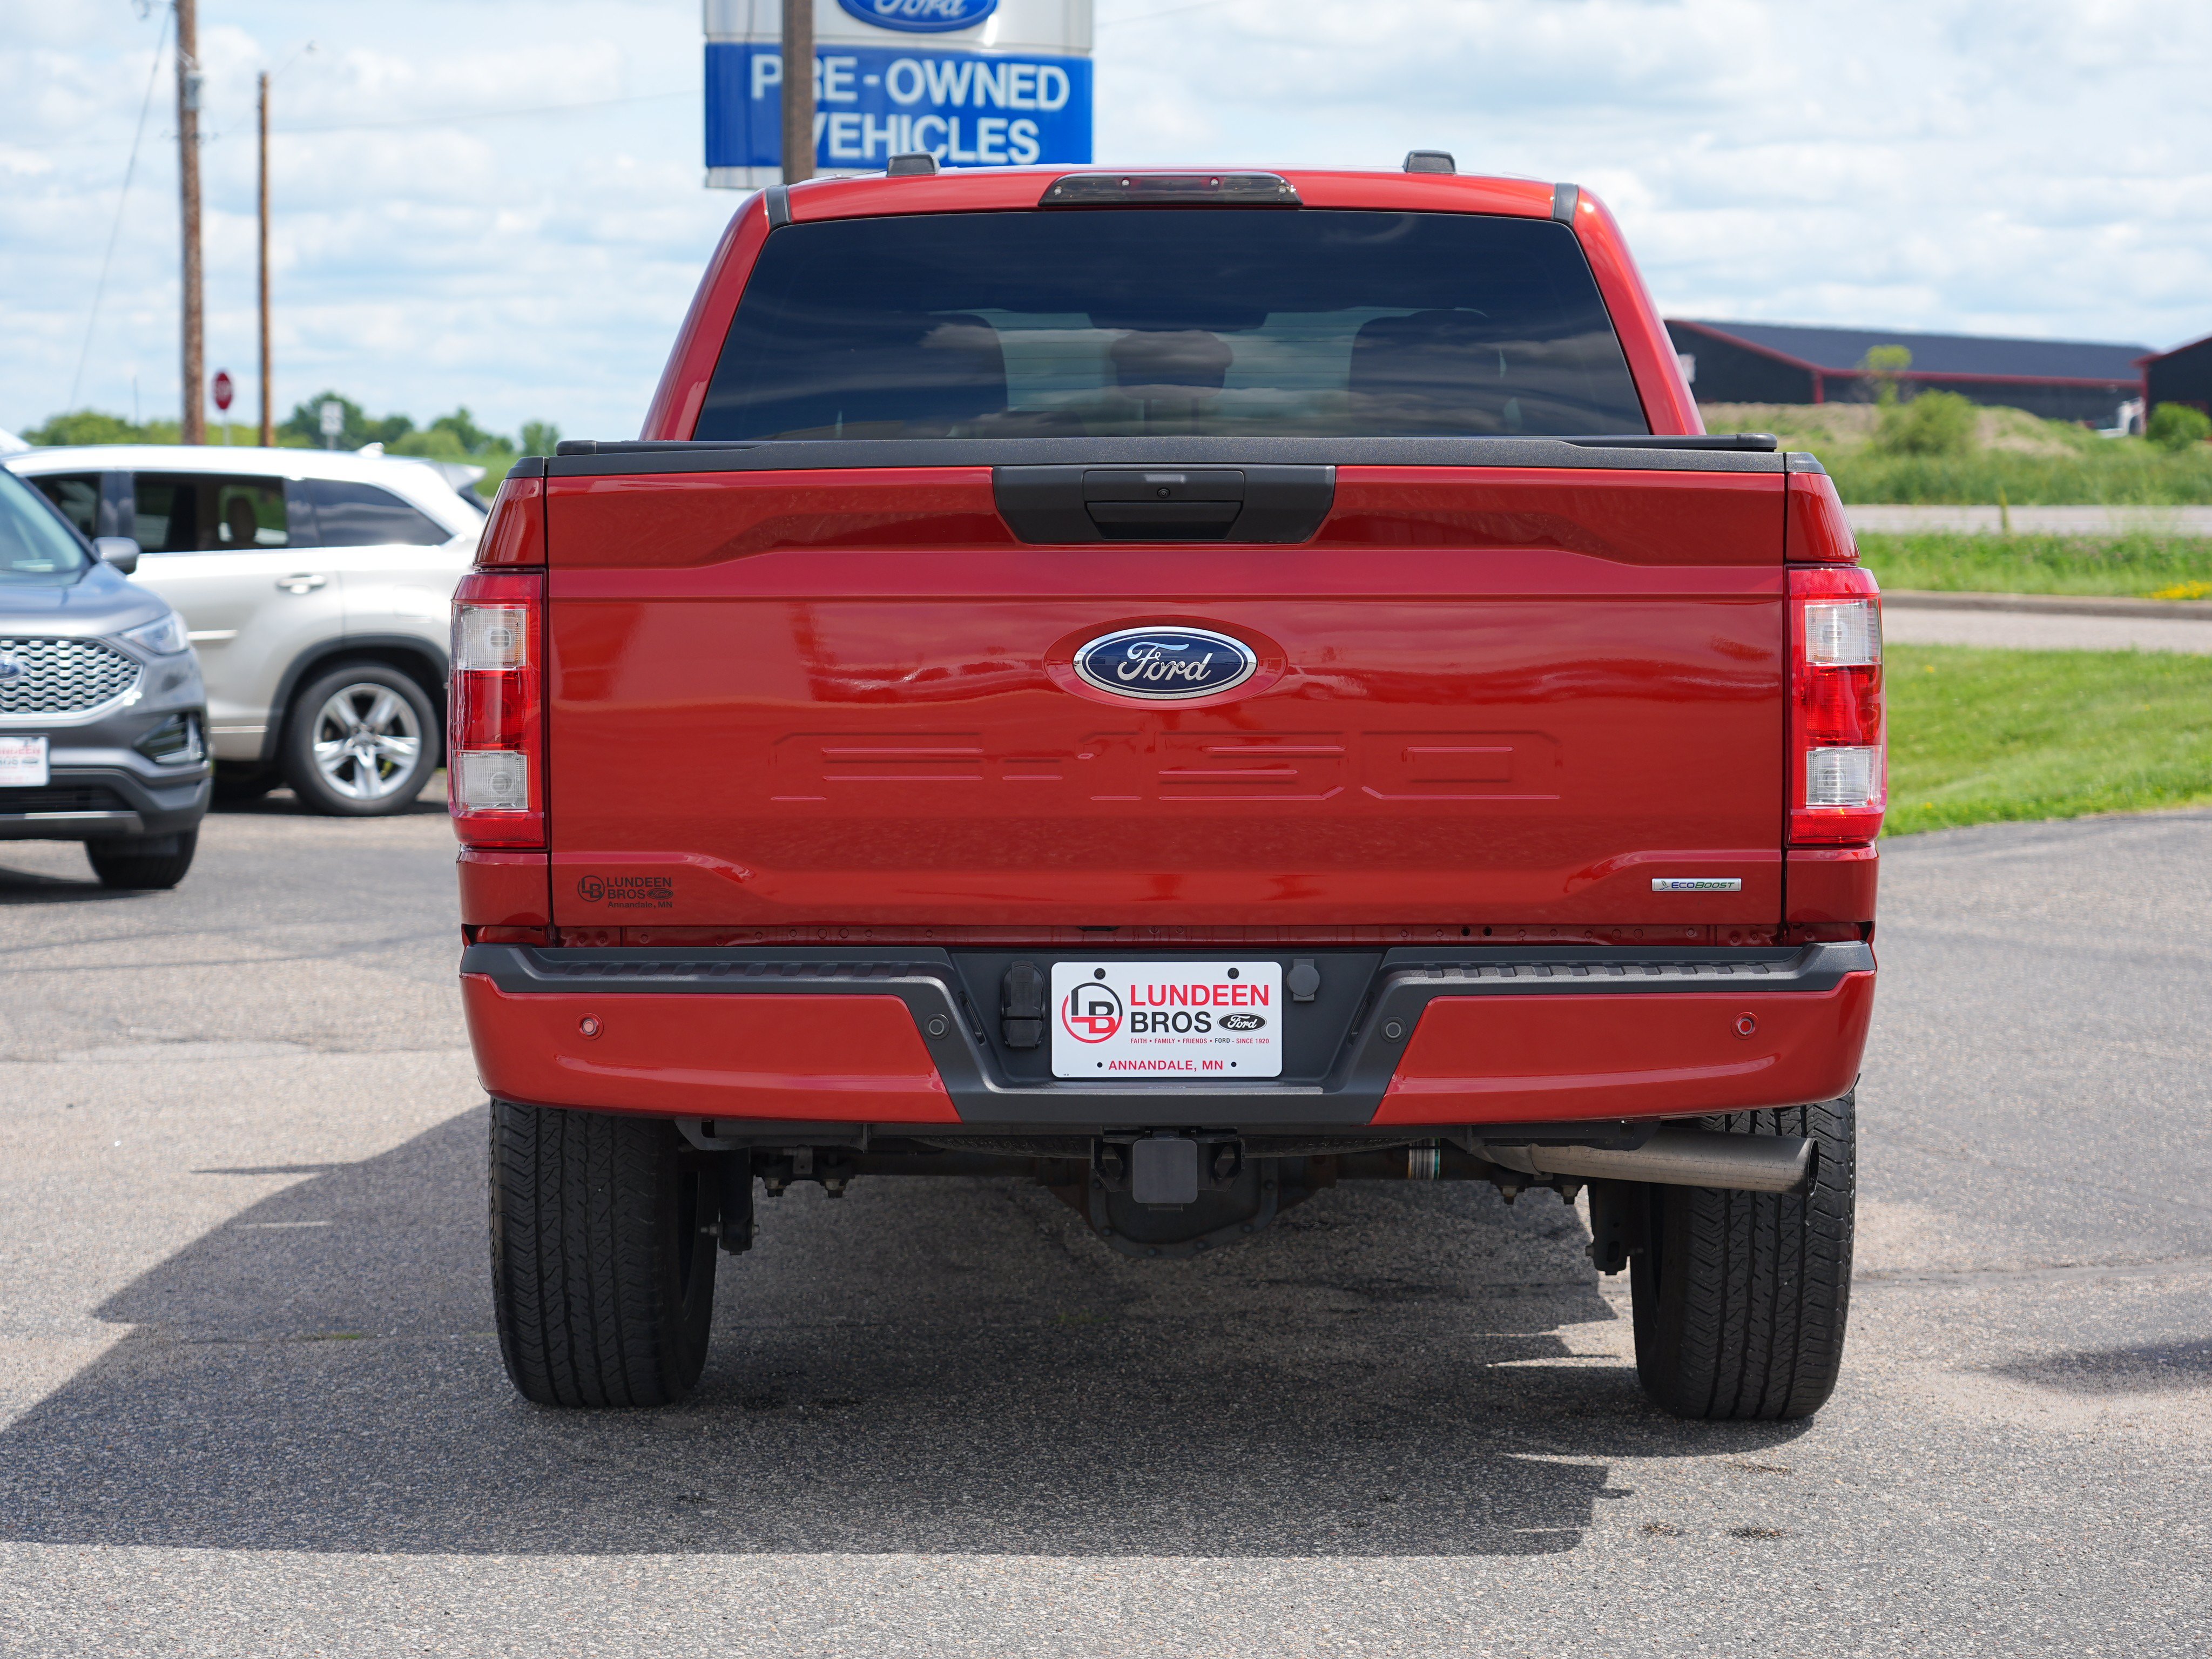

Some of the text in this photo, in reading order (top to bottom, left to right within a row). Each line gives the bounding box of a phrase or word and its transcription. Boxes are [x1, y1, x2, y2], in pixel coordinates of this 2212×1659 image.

[1117, 642, 1213, 680] Ford
[606, 877, 672, 887] LUNDEEN
[608, 889, 645, 899] BROS
[1130, 984, 1269, 1006] LUNDEEN
[1131, 1011, 1258, 1033] BROS Ford
[1109, 1060, 1223, 1071] ANNANDALE, MN
